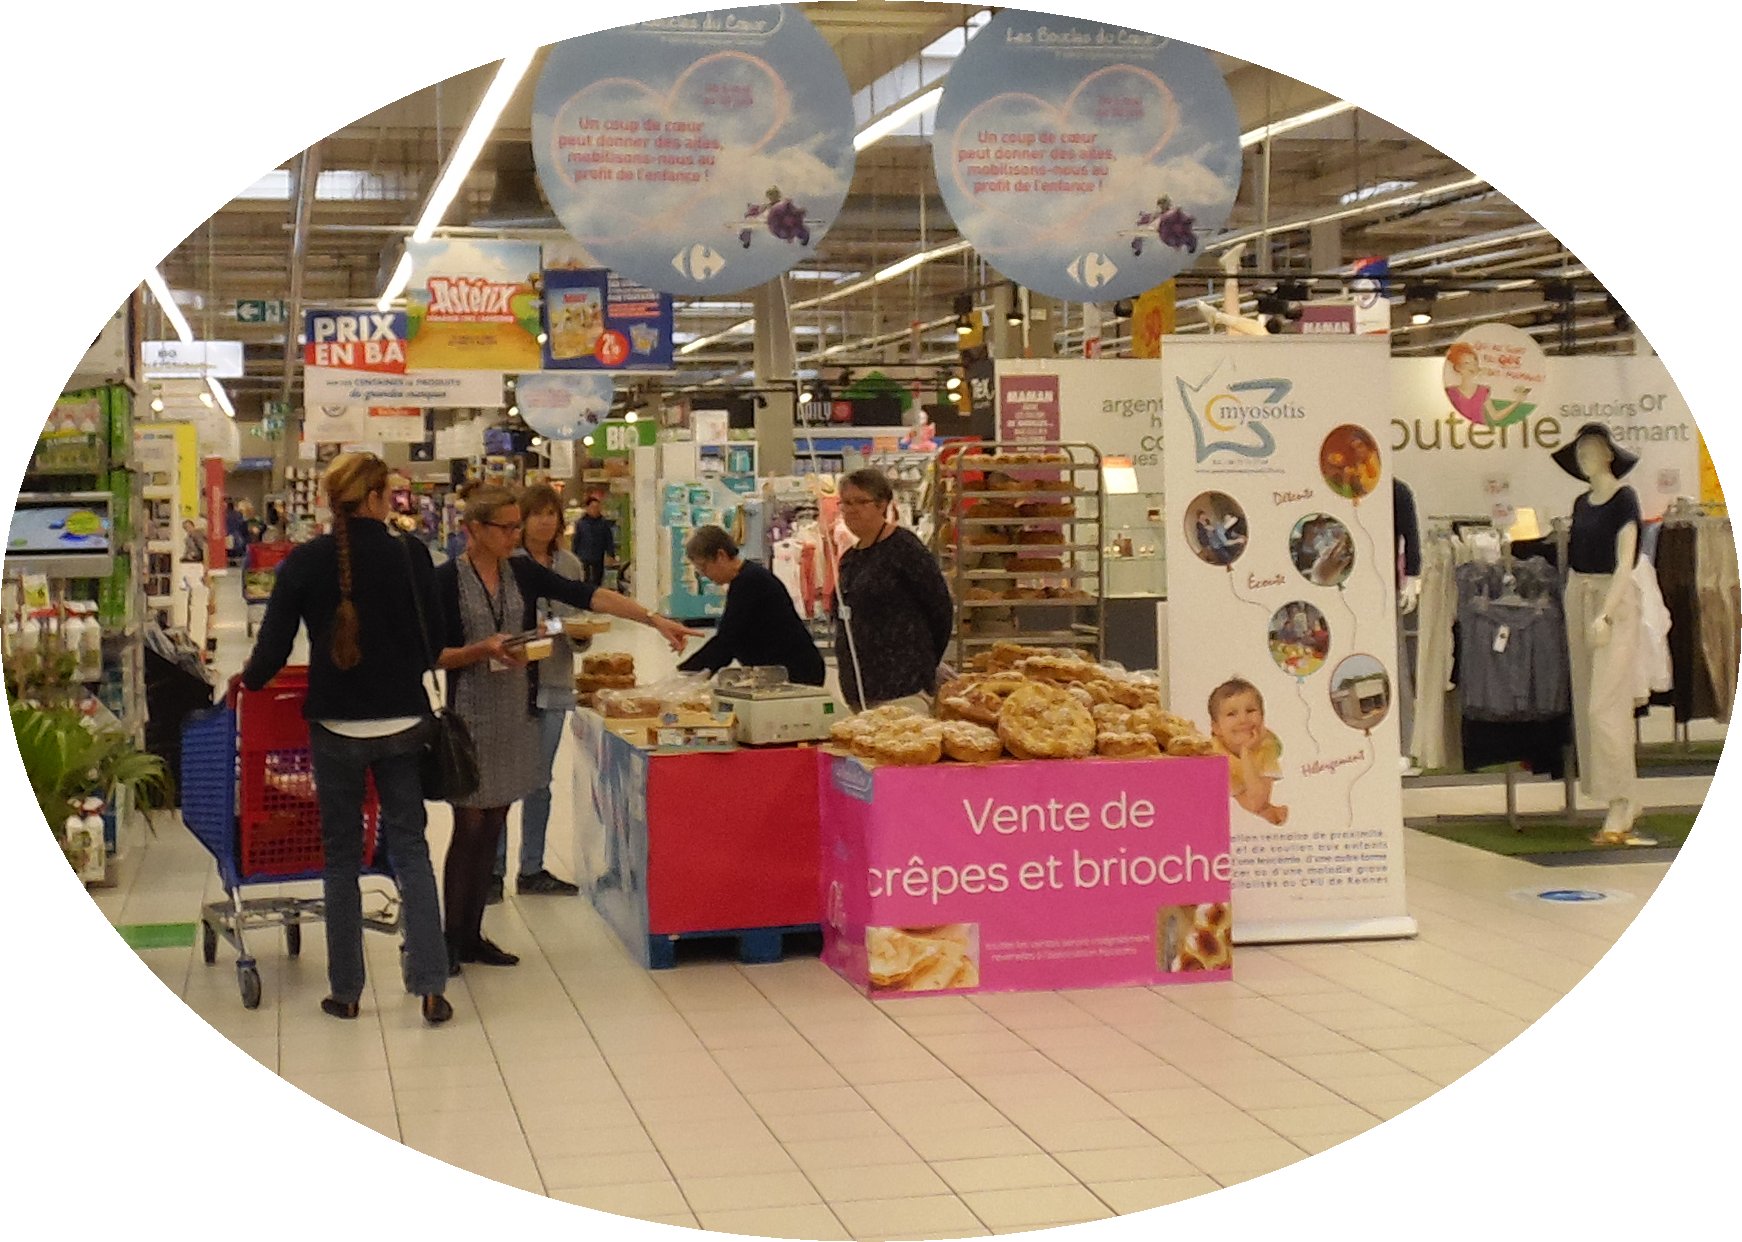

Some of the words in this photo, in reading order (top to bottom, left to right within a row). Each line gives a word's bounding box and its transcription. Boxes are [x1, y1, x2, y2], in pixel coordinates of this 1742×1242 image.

[579, 116, 600, 130] Un
[604, 120, 640, 132] coup
[643, 118, 661, 131] de
[558, 135, 592, 149] peut
[596, 135, 648, 147] donner
[978, 130, 998, 144] Un
[1001, 132, 1036, 146] coup
[1038, 131, 1056, 144] de
[958, 149, 992, 162] peut
[995, 149, 1044, 160] donner
[616, 168, 634, 181] de
[1014, 180, 1032, 192] de
[314, 314, 397, 343] PRIX
[315, 342, 354, 366] EN
[1006, 390, 1054, 402] MAMAN
[1219, 403, 1306, 425] myosotis
[1560, 400, 1638, 417] sautoirs
[606, 426, 640, 451] BIO
[1608, 420, 1691, 441] amant
[962, 797, 1092, 837] Vente
[1100, 790, 1156, 831] de
[868, 855, 1010, 905] crêpes
[1018, 853, 1064, 891] et
[1072, 844, 1231, 889] brioche
